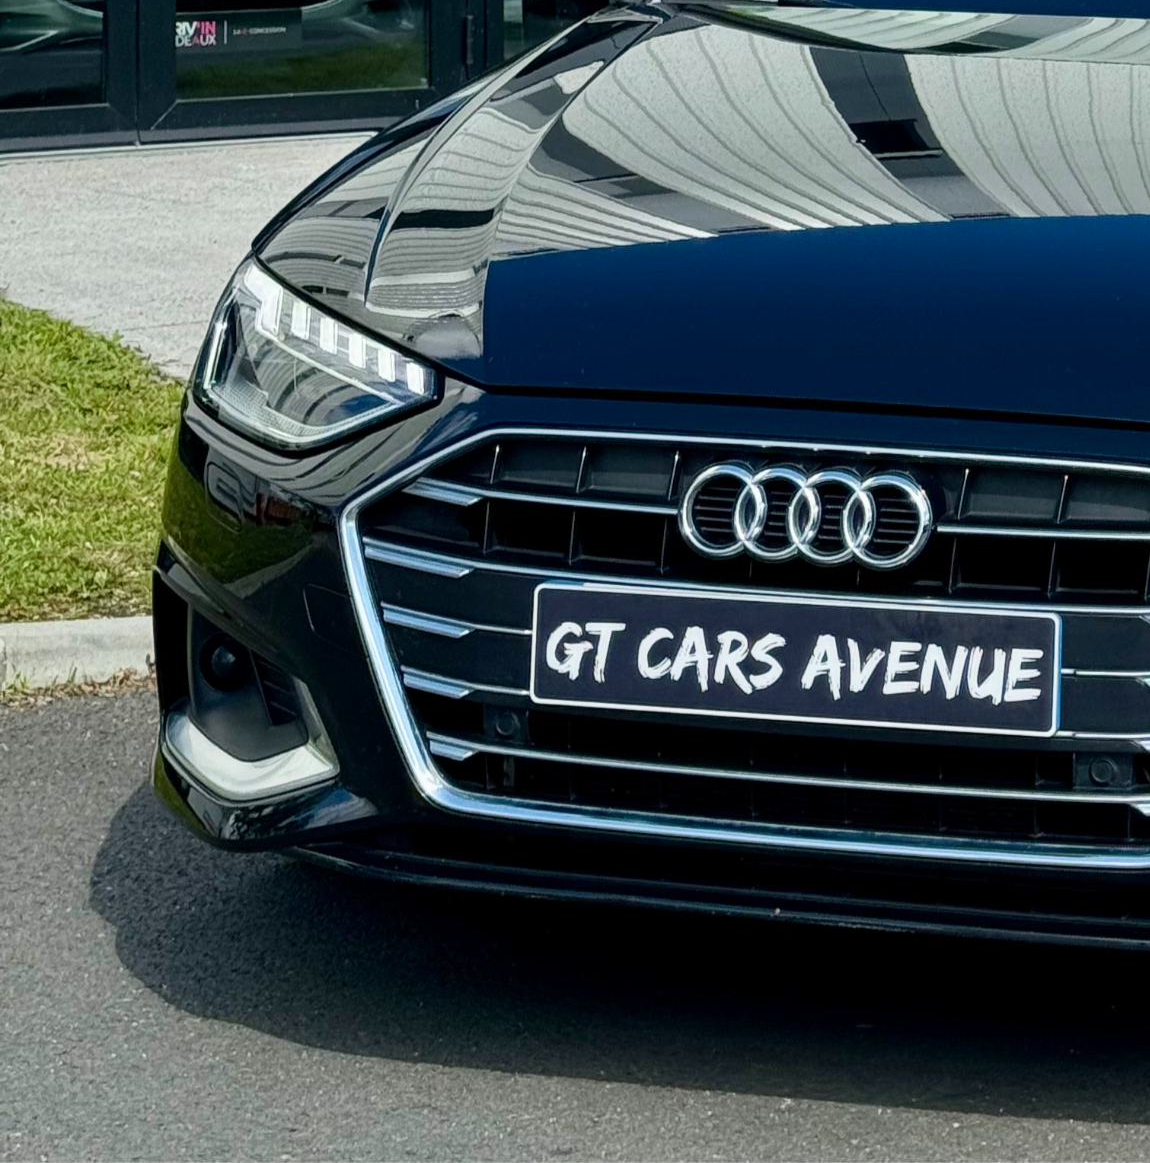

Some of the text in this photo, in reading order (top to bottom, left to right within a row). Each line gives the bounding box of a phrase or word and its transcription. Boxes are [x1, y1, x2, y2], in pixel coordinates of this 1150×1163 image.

[546, 621, 1044, 706] GT CARS AVENUE
